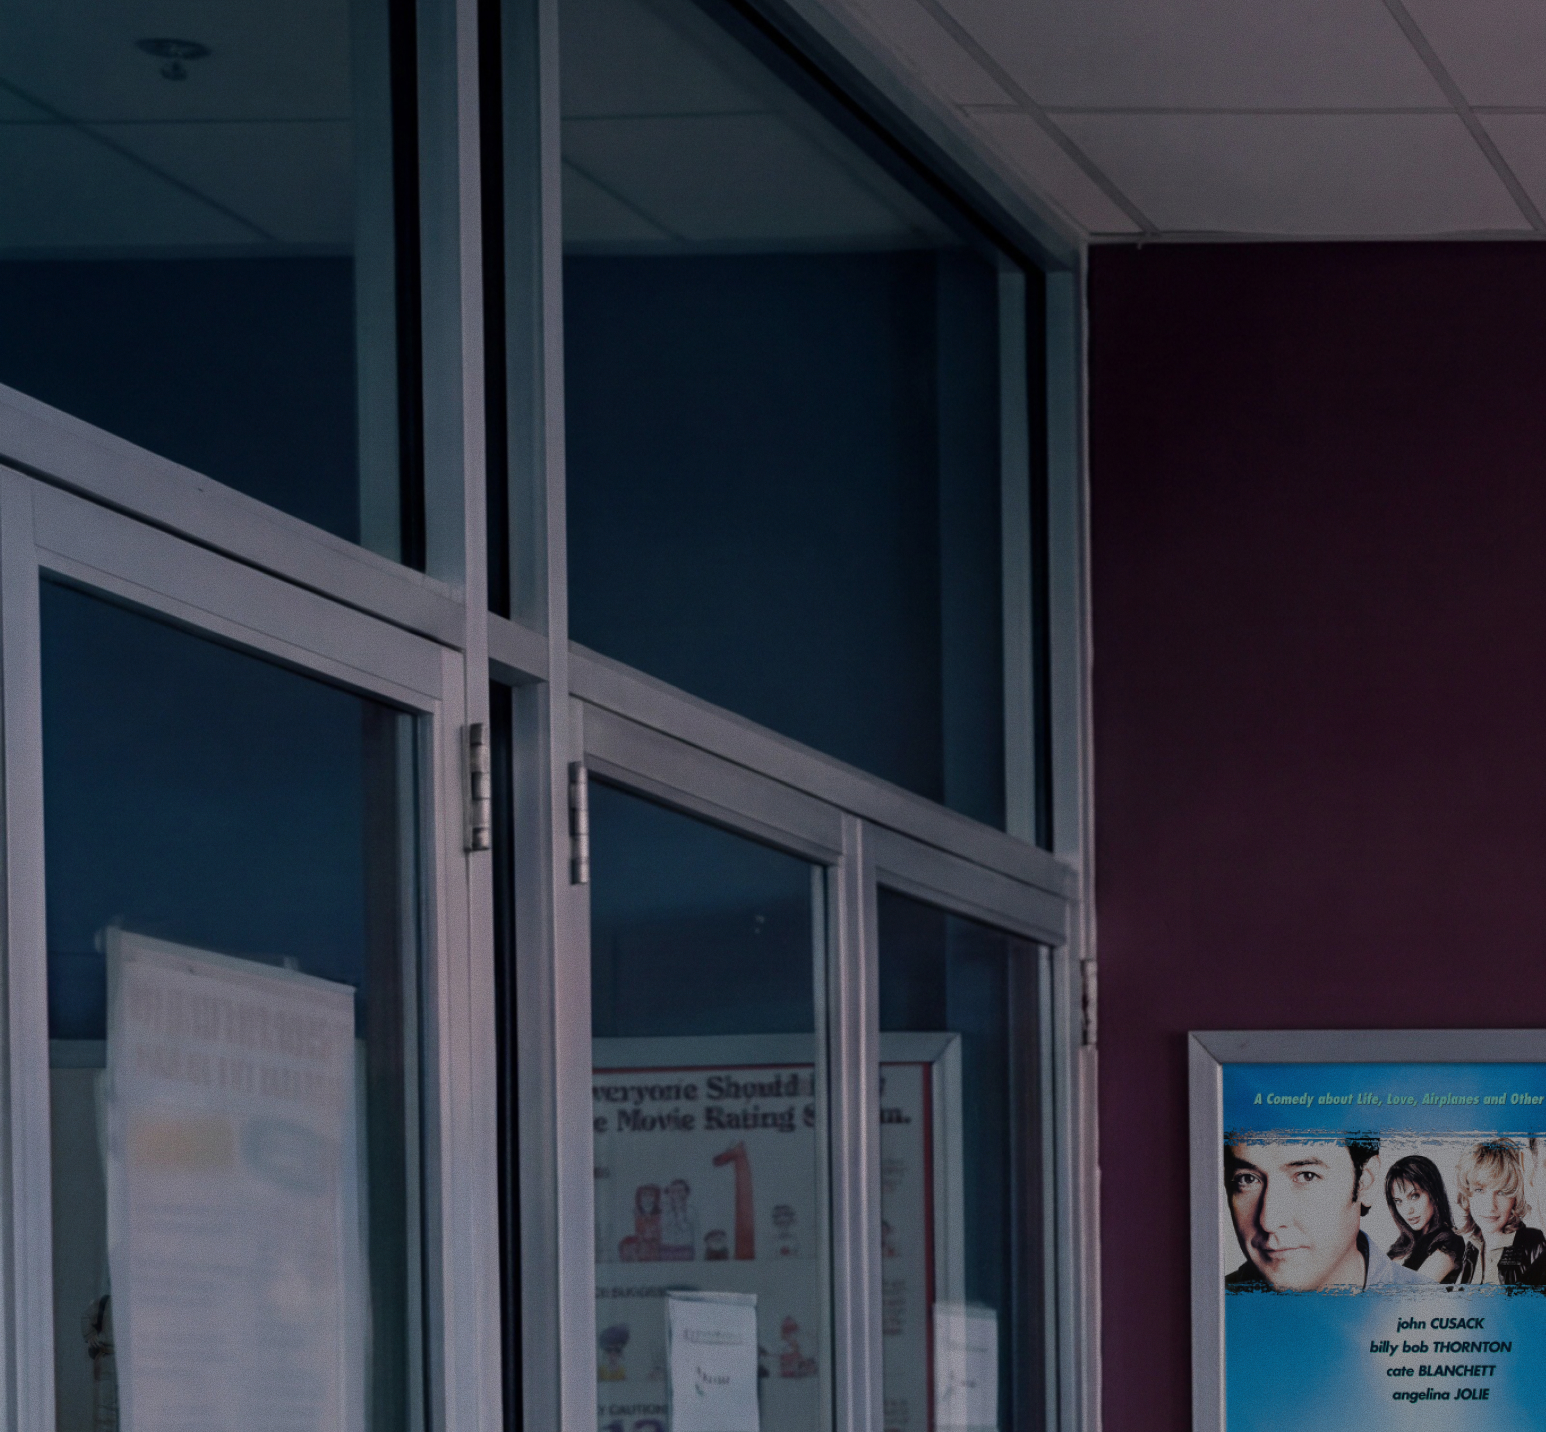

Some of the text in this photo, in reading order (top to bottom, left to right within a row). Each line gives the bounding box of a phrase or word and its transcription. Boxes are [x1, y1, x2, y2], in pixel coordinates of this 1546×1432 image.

[594, 1081, 697, 1105] veryone
[707, 1075, 799, 1099] Should
[1254, 1092, 1263, 1105] A
[1267, 1092, 1314, 1109] Comedy
[1318, 1092, 1353, 1106] about
[1357, 1092, 1383, 1107] Life,
[1387, 1092, 1418, 1107] Love,
[1422, 1092, 1479, 1109] Airplanes
[1483, 1092, 1506, 1106] and
[1510, 1092, 1545, 1106] Other
[616, 1108, 695, 1132] Movie
[704, 1104, 795, 1132] Rating
[1397, 1317, 1485, 1332] john CUSACK
[1369, 1341, 1512, 1356] billy bob THORNTON
[1386, 1365, 1496, 1377] cate BLANCHETT
[1392, 1388, 1490, 1403] angelina JOLIE
